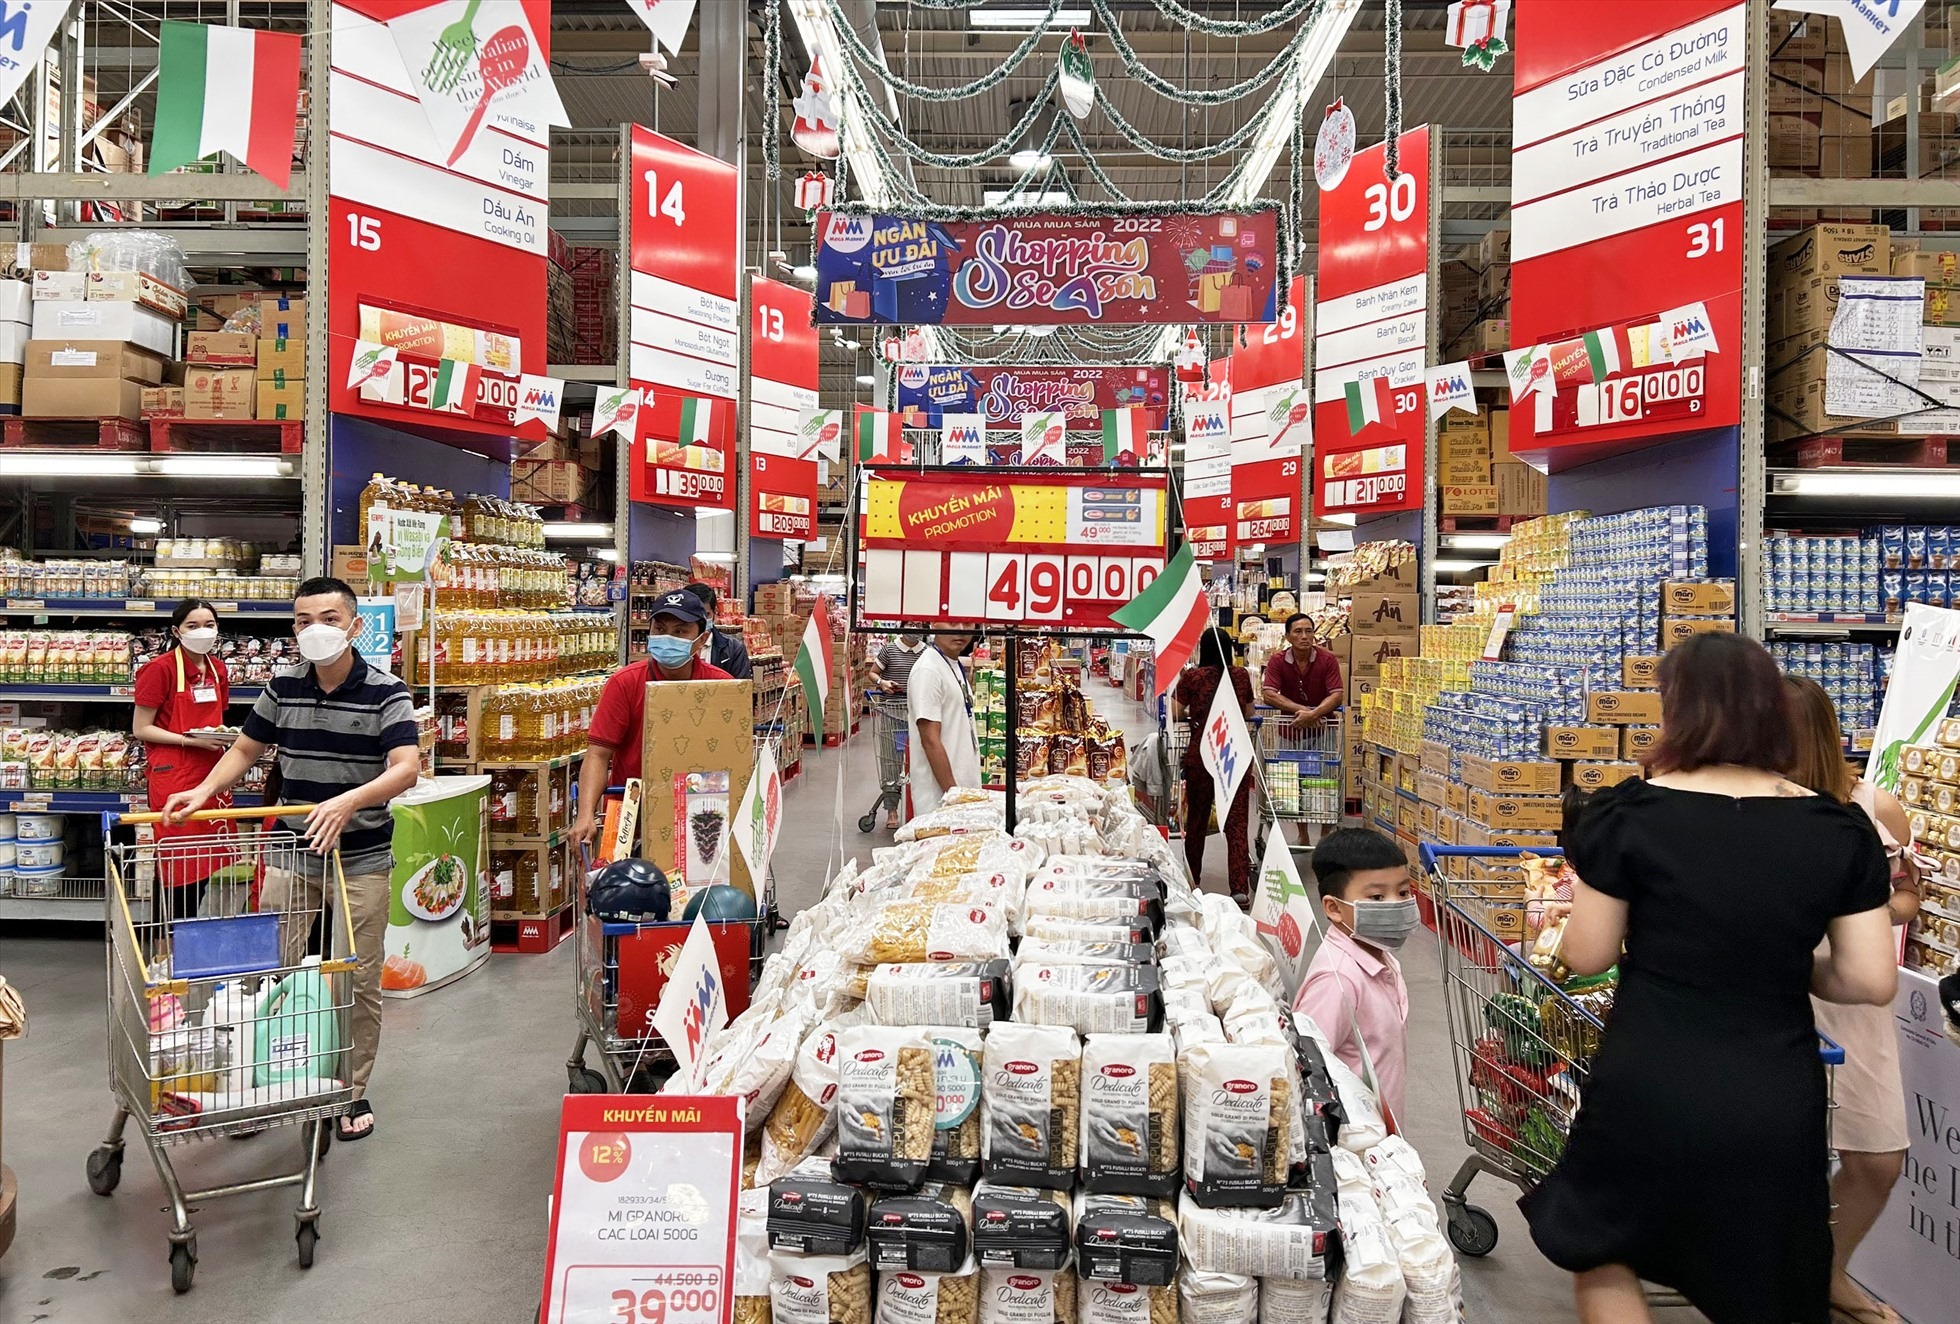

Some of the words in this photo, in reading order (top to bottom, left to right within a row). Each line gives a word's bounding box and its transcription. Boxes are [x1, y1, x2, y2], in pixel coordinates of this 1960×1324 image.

[432, 30, 481, 53] Week
[472, 35, 528, 61] Italian
[1568, 79, 1599, 101] Sữa
[1604, 64, 1635, 85] Đặc
[1642, 50, 1664, 71] Có
[1638, 60, 1701, 92] Condensed
[1705, 50, 1727, 67] Milk
[455, 86, 483, 103] the
[485, 63, 541, 91] World
[1670, 94, 1726, 124] Thống
[1640, 124, 1699, 153] Traditional
[1703, 118, 1726, 133] Tea
[498, 168, 534, 190] Vinegar
[1673, 166, 1721, 187] Dược
[645, 170, 685, 226] 14
[1363, 172, 1417, 232] 30
[1657, 194, 1694, 215] Herbal
[1699, 189, 1721, 201] Tea
[515, 205, 535, 228] Ăn
[1013, 220, 1041, 229] MÙA
[1043, 220, 1072, 229] MUA
[1113, 218, 1163, 233] 2022
[347, 213, 382, 251] 15
[484, 221, 523, 244] Cooking
[524, 232, 535, 245] Oil
[873, 221, 927, 247] NGÀN
[1687, 218, 1724, 259] 31
[905, 238, 938, 262] ĐÃI
[1838, 246, 1875, 263] STARS
[953, 224, 1149, 310] Shopping
[1400, 285, 1418, 297] Kem
[1381, 303, 1402, 313] Creamy
[1403, 298, 1418, 307] Cake
[759, 304, 784, 343] 13
[394, 336, 436, 350] PROMOTION
[1397, 334, 1416, 345] Biscuit
[1073, 369, 1103, 379] 2022
[1394, 374, 1416, 385] Cracker
[639, 387, 655, 408] 14
[1395, 392, 1417, 414] 30
[755, 456, 766, 471] 13
[1282, 461, 1297, 476] 29
[1463, 486, 1497, 496] LOTTE
[908, 496, 971, 527] KHUYẾN
[973, 485, 1003, 505] MÃI
[924, 507, 998, 540] PROMOTION
[1373, 600, 1402, 622] An
[1007, 1063, 1037, 1072] granoro
[1104, 1067, 1133, 1076] granoro
[1091, 1075, 1145, 1097] Dedicato
[1226, 1082, 1256, 1091] granoro
[1212, 1090, 1267, 1113] Dedicato
[603, 1104, 667, 1123] KHUYẾN
[671, 1106, 701, 1123] MÃI
[1913, 1091, 1960, 1155] We
[1903, 1148, 1937, 1195] he
[608, 1210, 622, 1222] MI
[1909, 1190, 1938, 1245] in
[598, 1228, 626, 1241] CAC
[630, 1228, 659, 1241] LOAI
[663, 1228, 698, 1241] 500G
[655, 1274, 702, 1286] 44.500
[1009, 1277, 1039, 1288] granoro
[996, 1286, 1051, 1308] Dedicato
